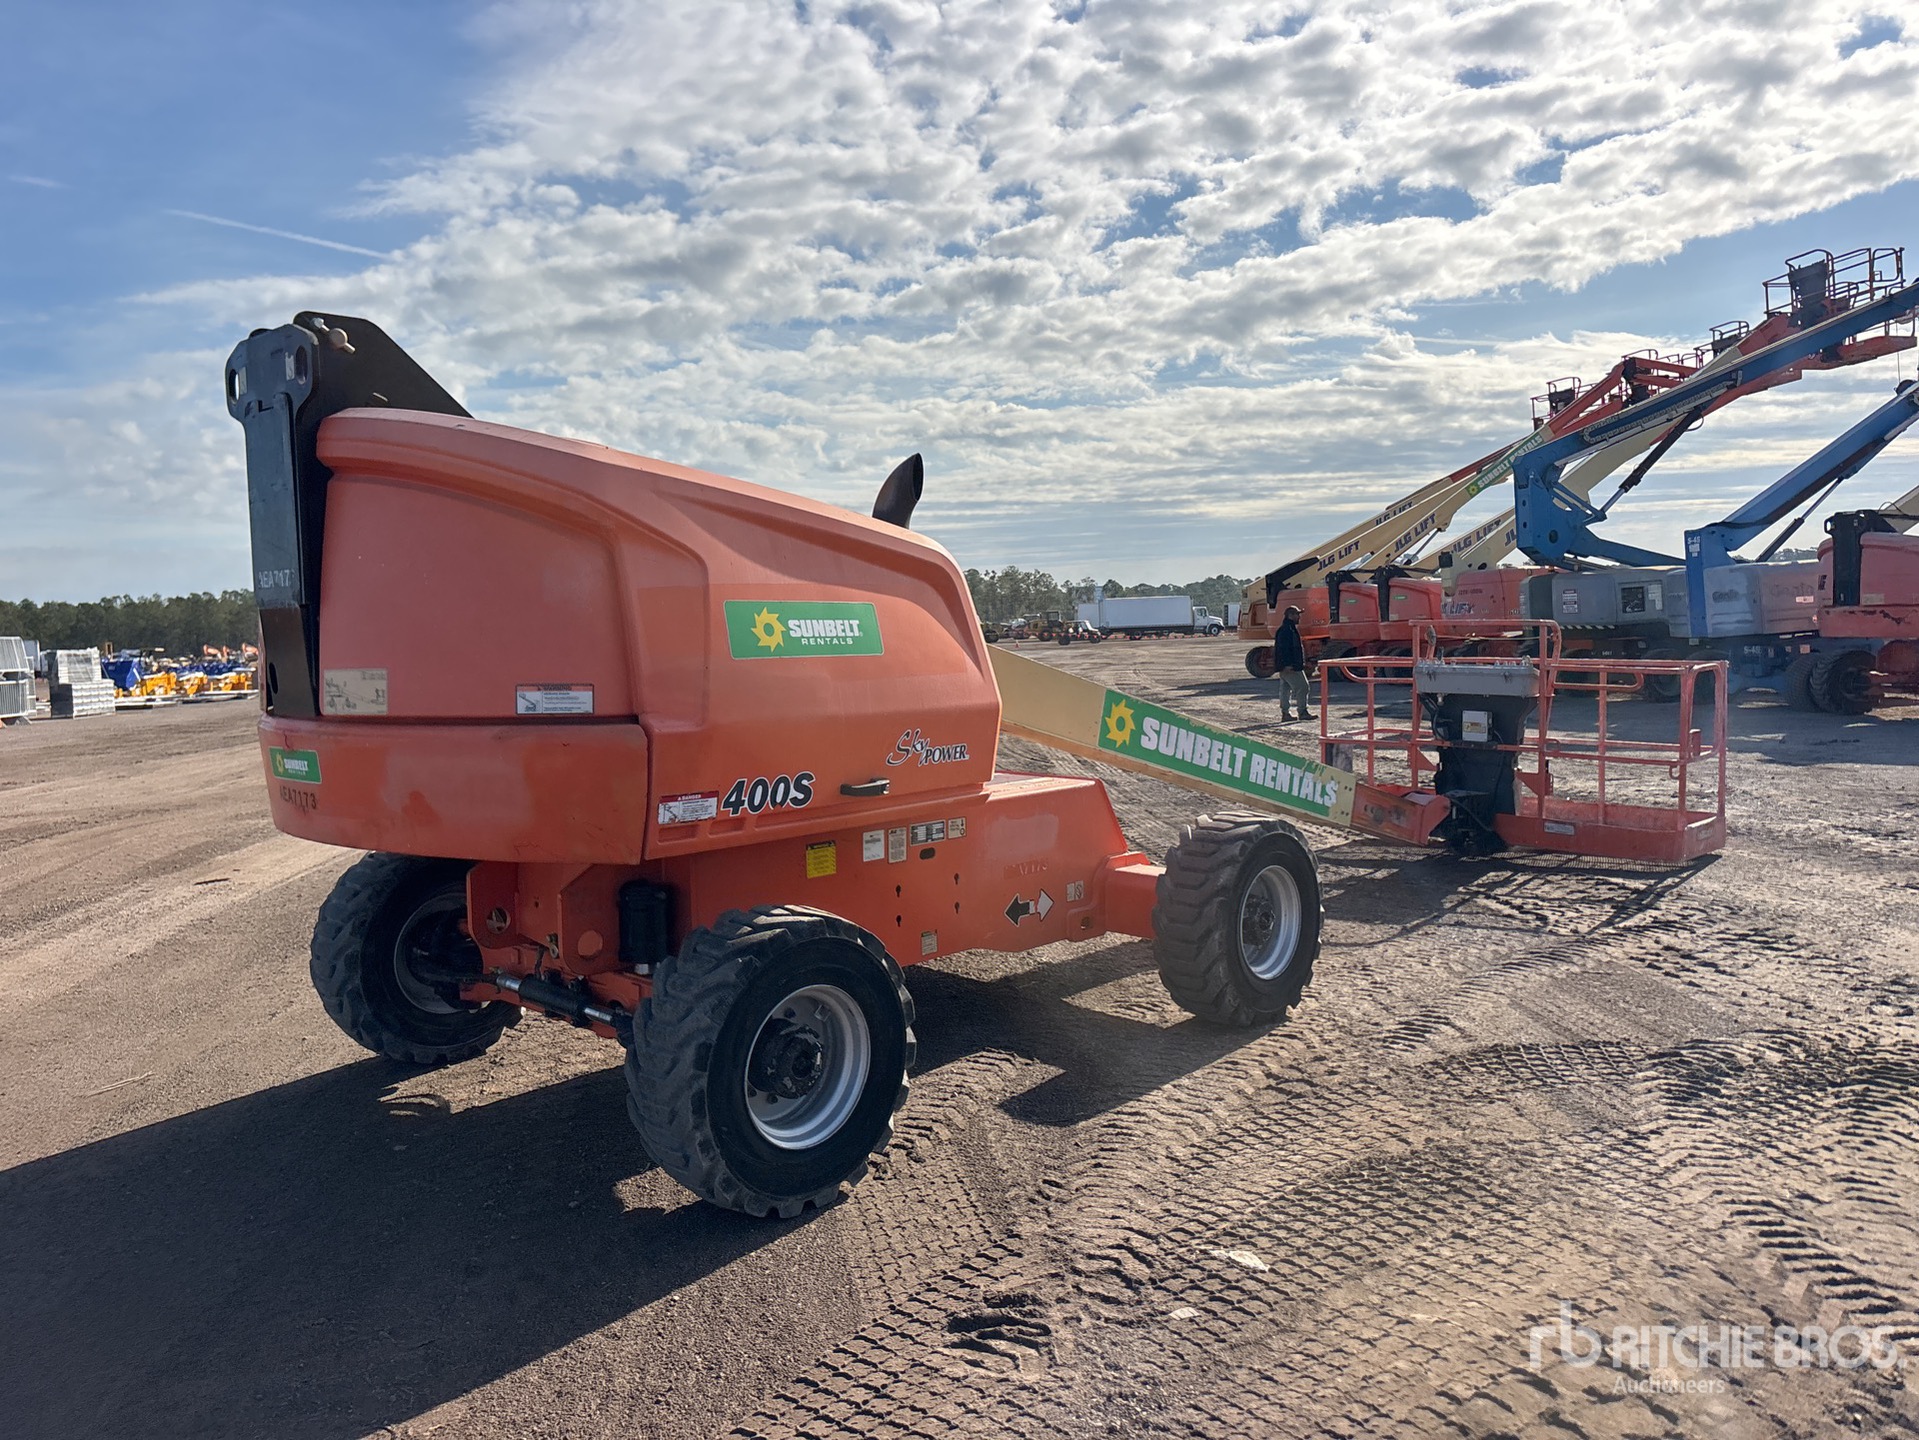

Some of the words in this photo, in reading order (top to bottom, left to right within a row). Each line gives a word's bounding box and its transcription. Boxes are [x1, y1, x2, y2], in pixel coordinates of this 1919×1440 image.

[1394, 531, 1412, 553] JLG
[1414, 513, 1436, 537] LIFT
[1505, 529, 1517, 547] JL
[1317, 554, 1336, 572] JLG
[1338, 540, 1360, 560] LIFT
[787, 619, 860, 638] SUNBELT
[801, 637, 854, 646] RENTALS
[886, 728, 930, 767] Sky
[923, 743, 970, 766] POWER
[1140, 716, 1247, 779] SUNBELT
[1249, 753, 1339, 807] RENTALS
[283, 758, 308, 771] SUNBELT
[720, 771, 816, 817] 400S
